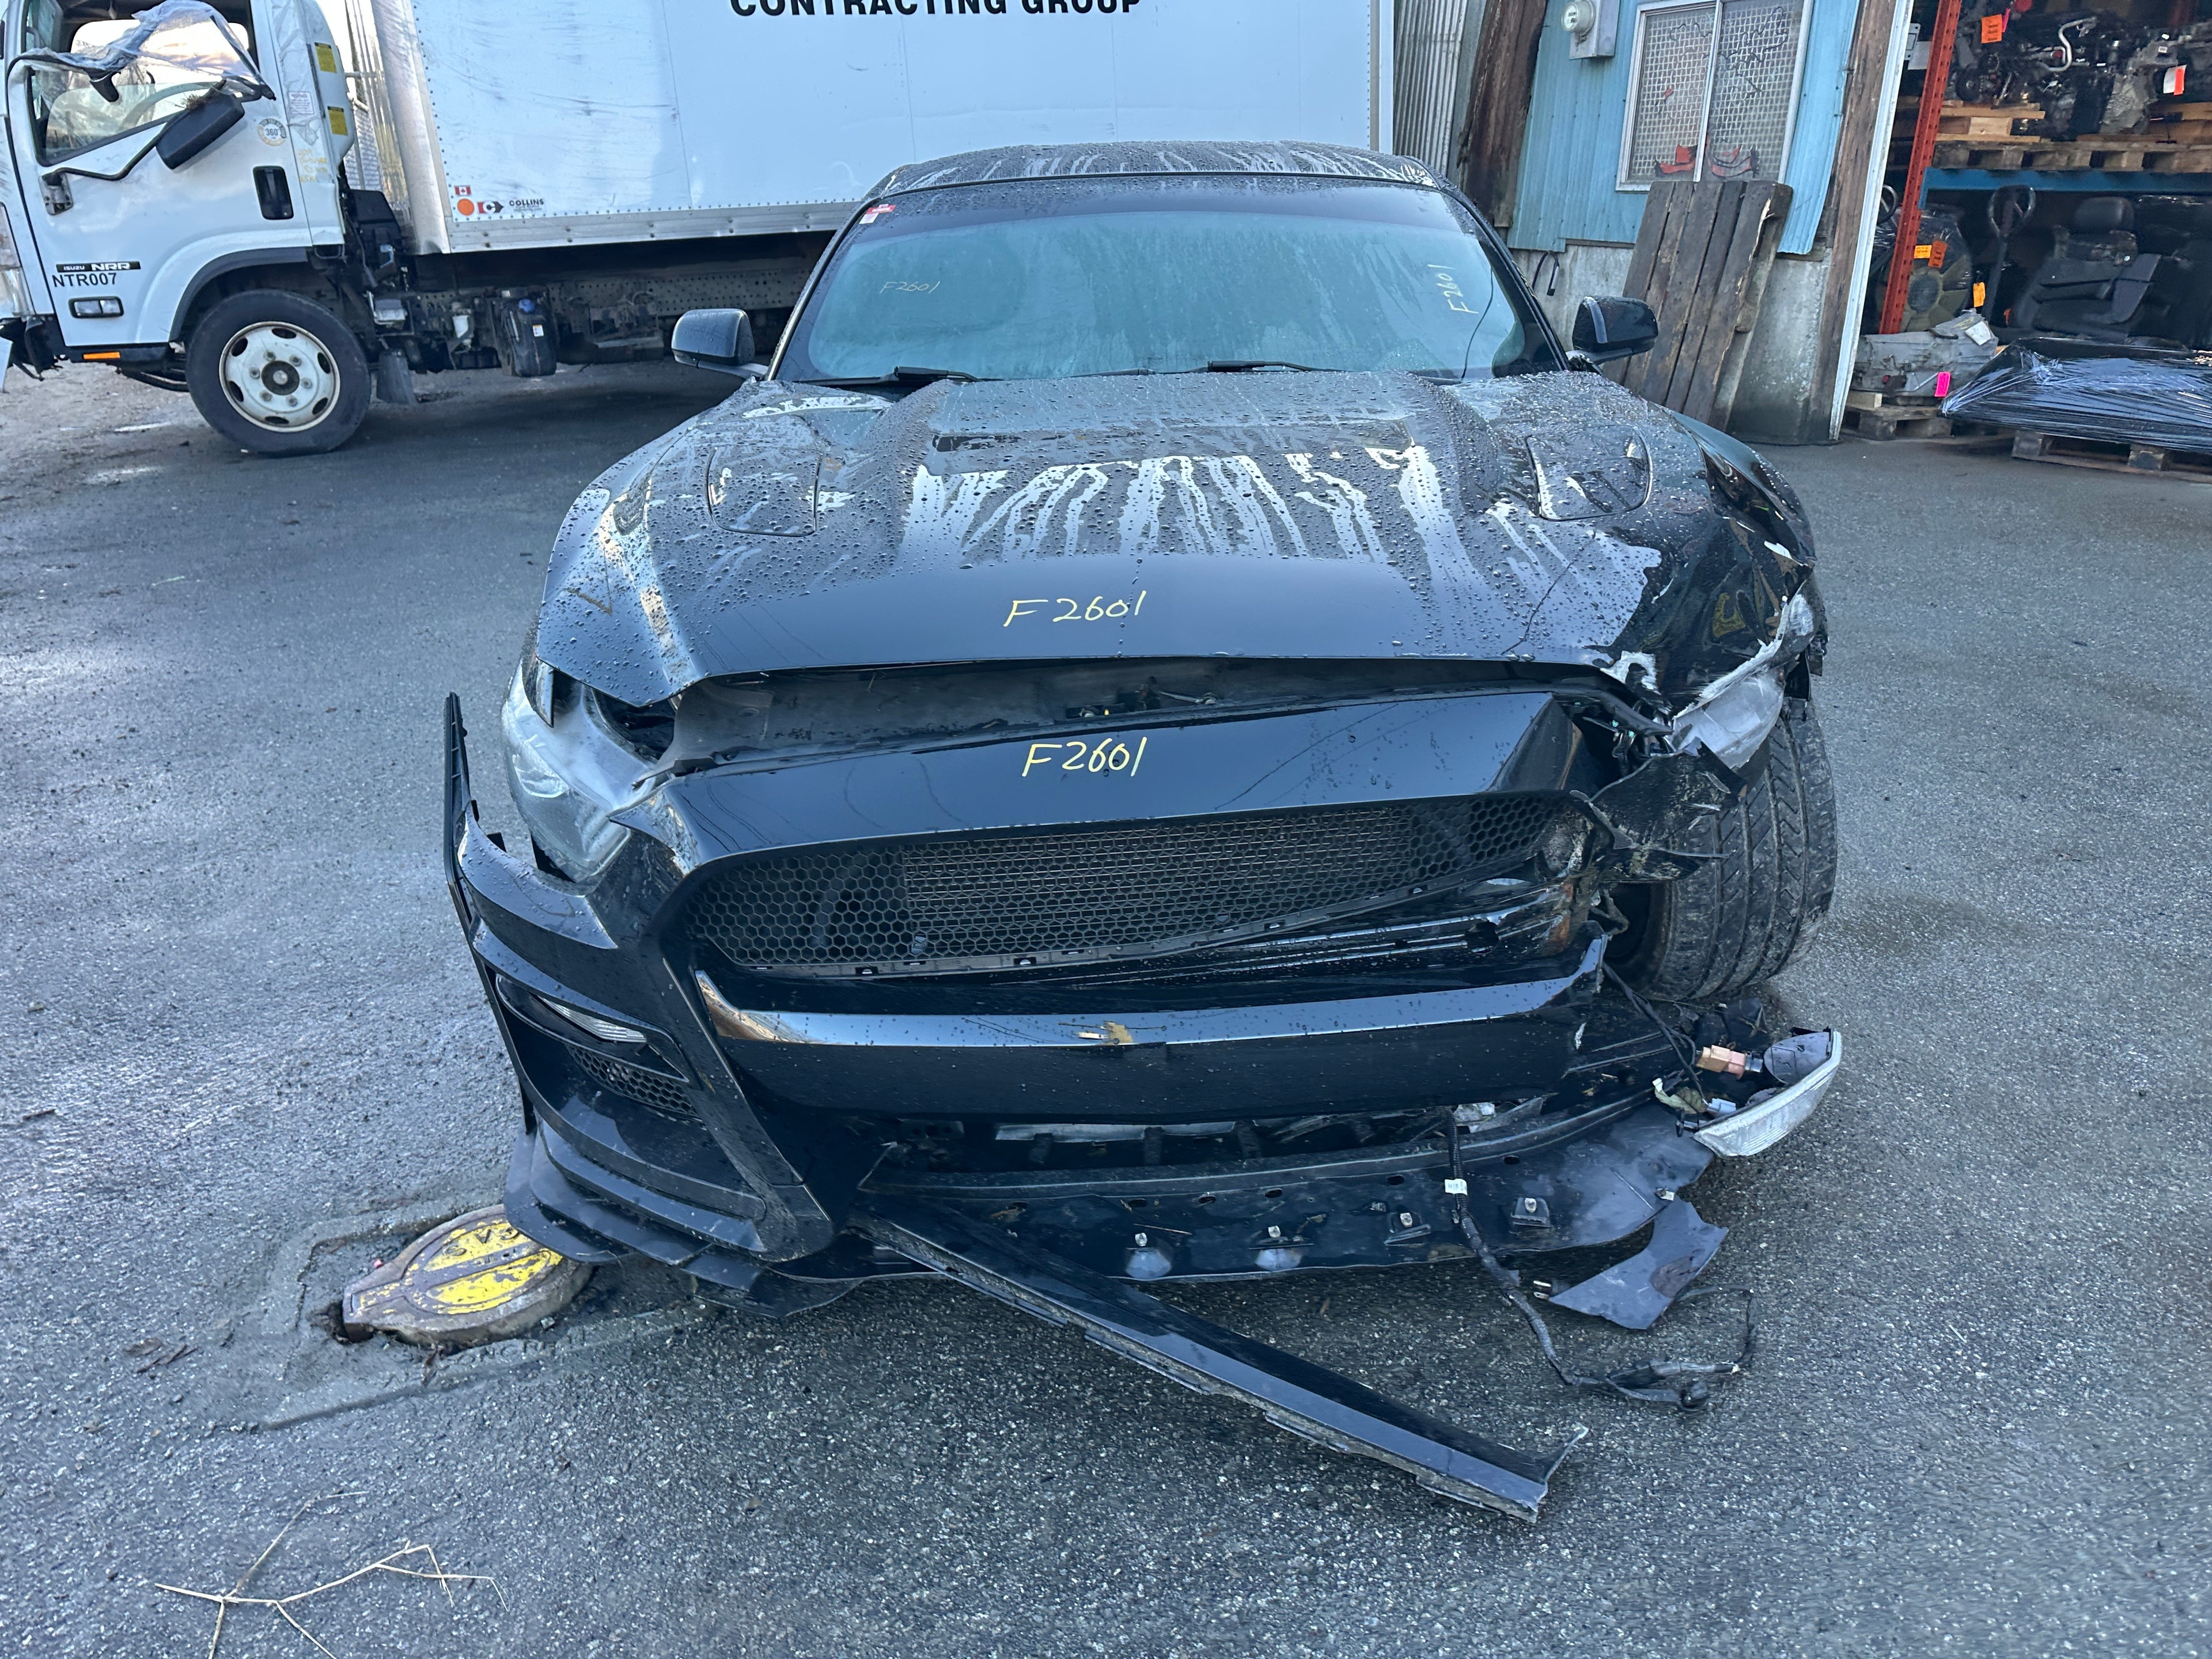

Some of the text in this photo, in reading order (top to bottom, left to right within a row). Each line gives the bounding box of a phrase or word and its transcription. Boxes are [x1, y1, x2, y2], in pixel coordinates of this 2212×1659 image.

[52, 272, 116, 287] NTR007
[91, 263, 130, 271] NRR
[879, 281, 940, 294] F2601
[1427, 264, 1479, 314] F2601
[1003, 590, 1146, 627] F2601
[1021, 736, 1147, 777] F2601
